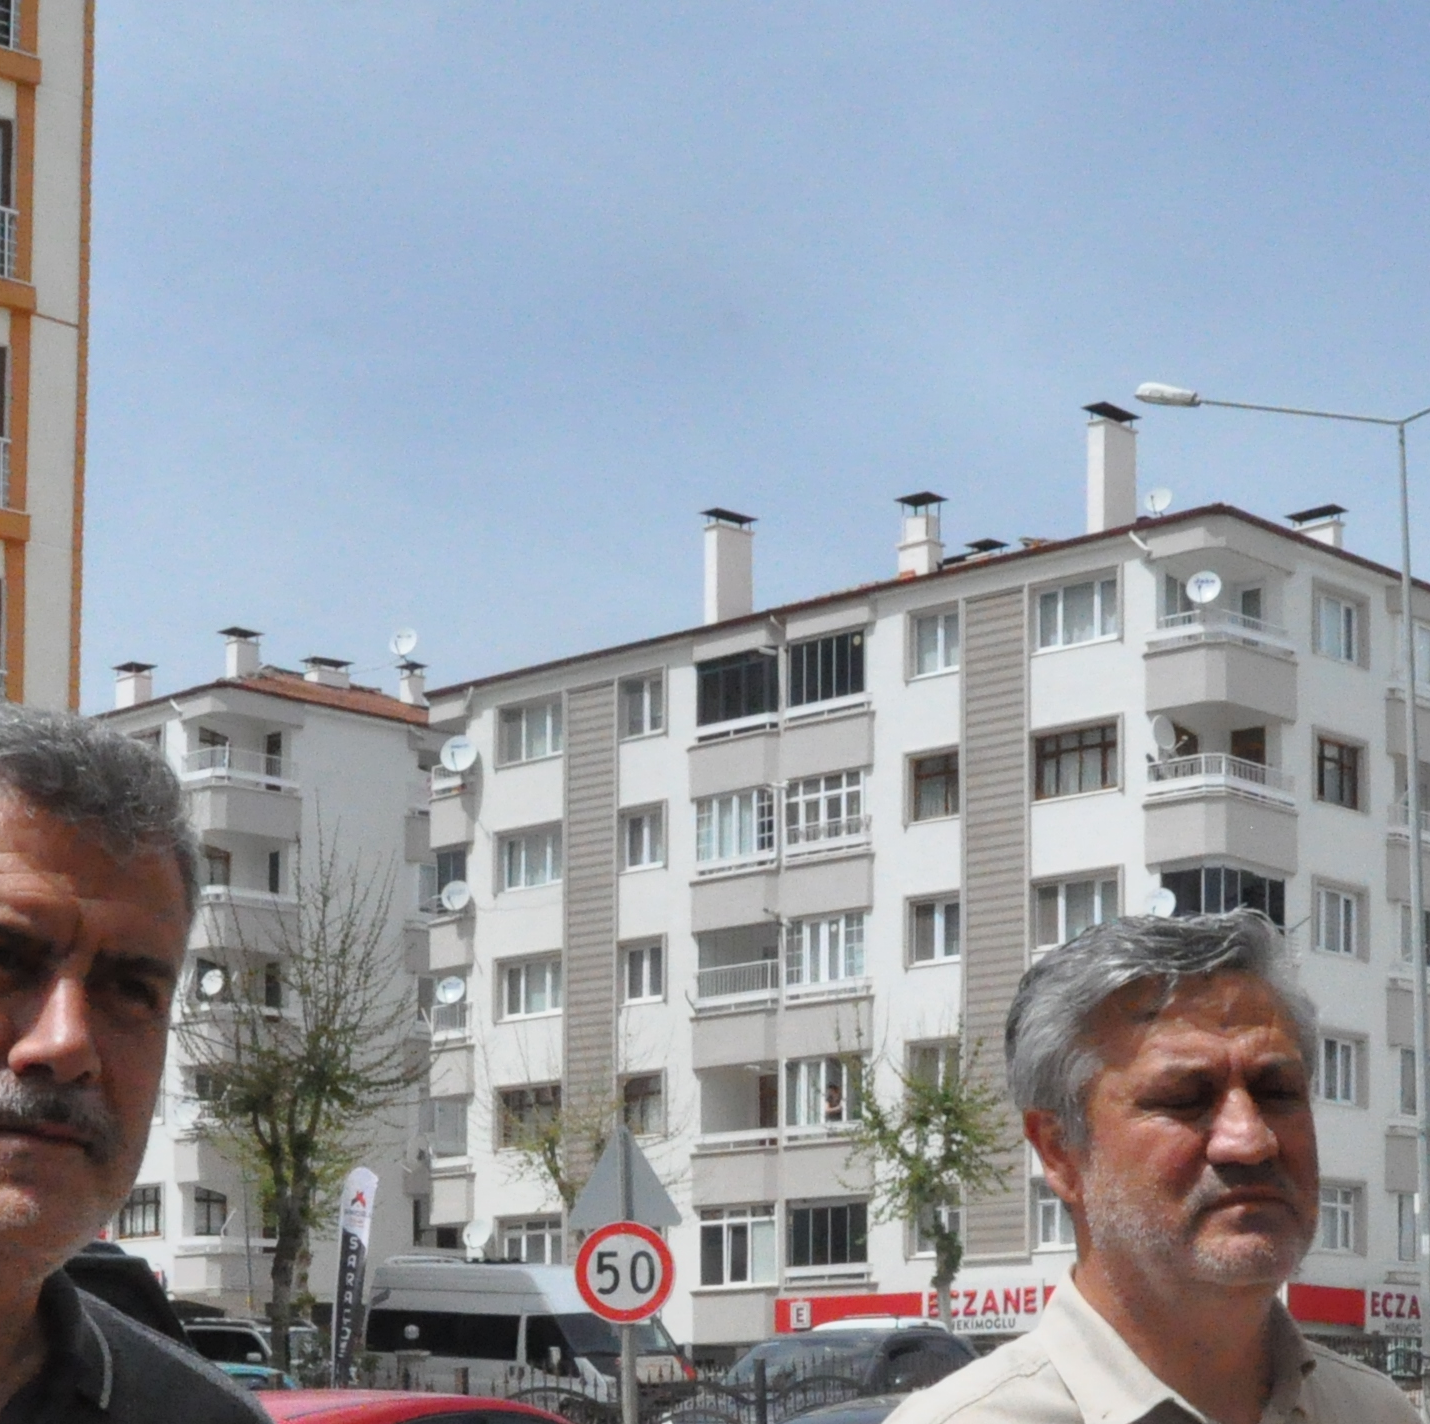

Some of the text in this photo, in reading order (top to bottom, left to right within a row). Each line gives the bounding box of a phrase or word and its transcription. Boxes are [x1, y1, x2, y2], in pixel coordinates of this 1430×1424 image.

[596, 1250, 655, 1295] 50
[796, 1307, 804, 1323] E
[1371, 1291, 1421, 1319] ECZA
